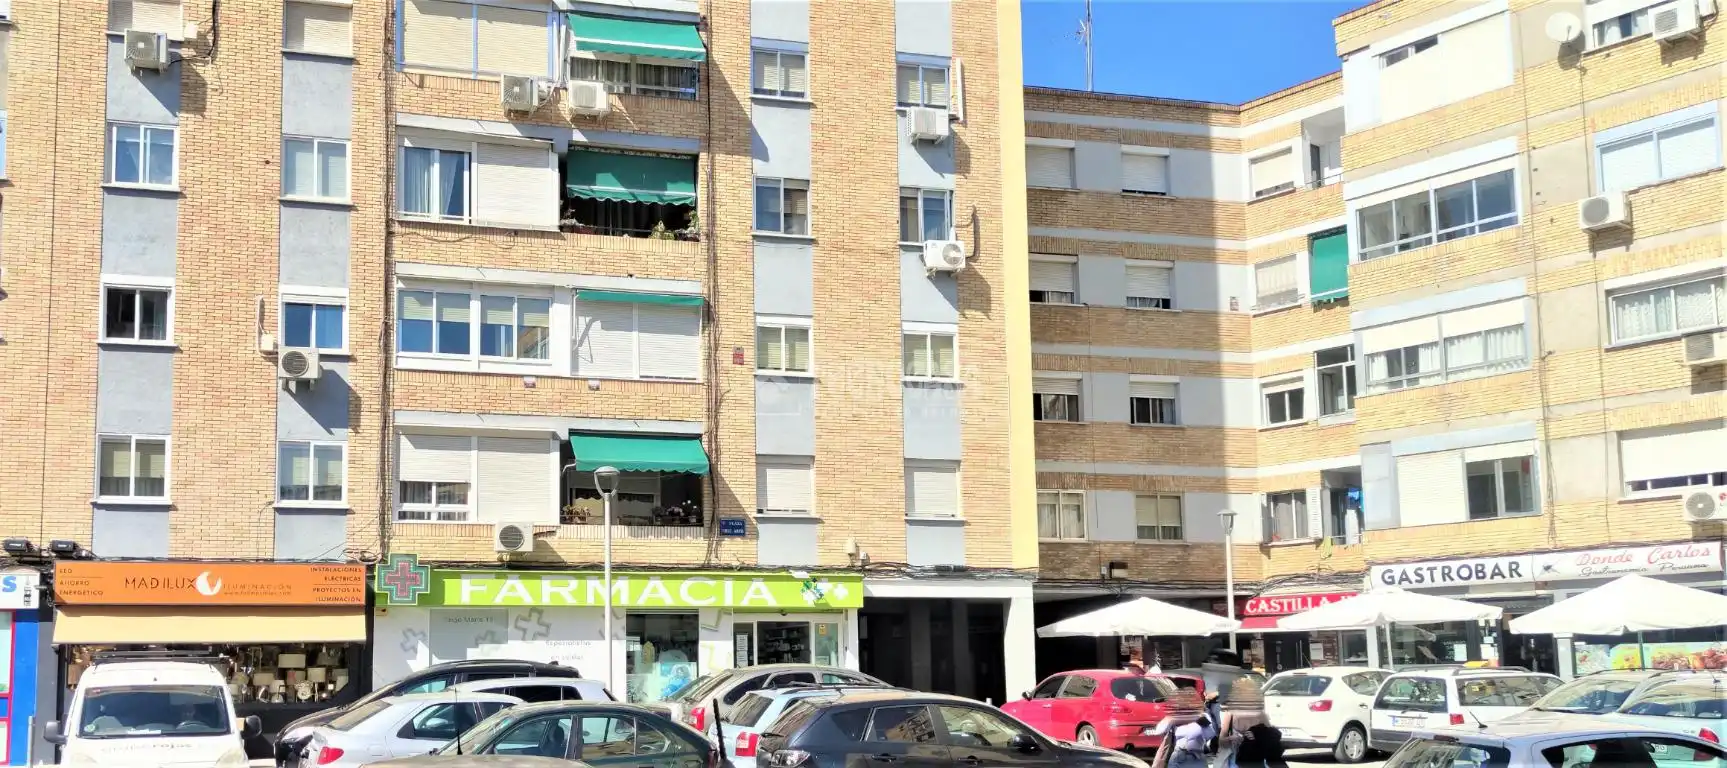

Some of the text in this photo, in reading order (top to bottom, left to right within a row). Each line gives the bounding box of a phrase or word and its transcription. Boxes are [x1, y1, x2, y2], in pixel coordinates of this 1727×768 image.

[1576, 545, 1711, 566] Donde Carlos
[124, 576, 198, 590] MADILUX
[1381, 561, 1523, 585] GASTROBAR
[460, 573, 778, 607] FARMACIA
[1245, 595, 1331, 613] CASTILLA
